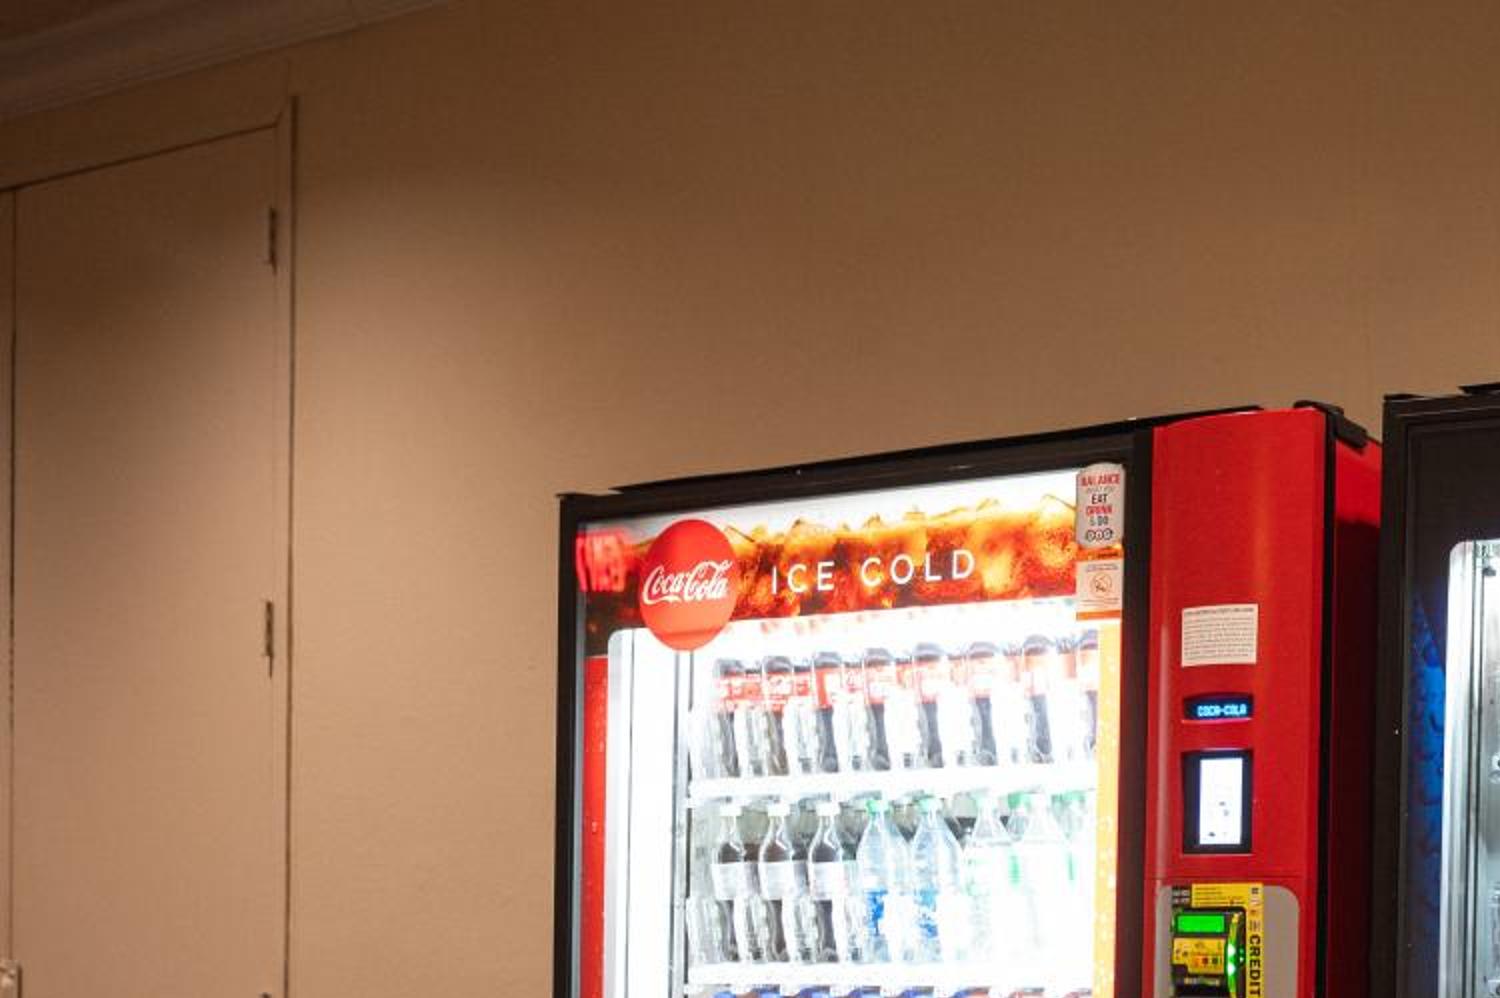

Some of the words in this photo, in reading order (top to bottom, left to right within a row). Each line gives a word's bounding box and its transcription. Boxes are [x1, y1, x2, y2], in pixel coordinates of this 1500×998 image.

[1091, 493, 1108, 504] EAT
[642, 559, 733, 605] Coca-Cola
[771, 562, 835, 595] ICE
[861, 549, 976, 587] COLD
[1249, 933, 1262, 997] CREDIT
